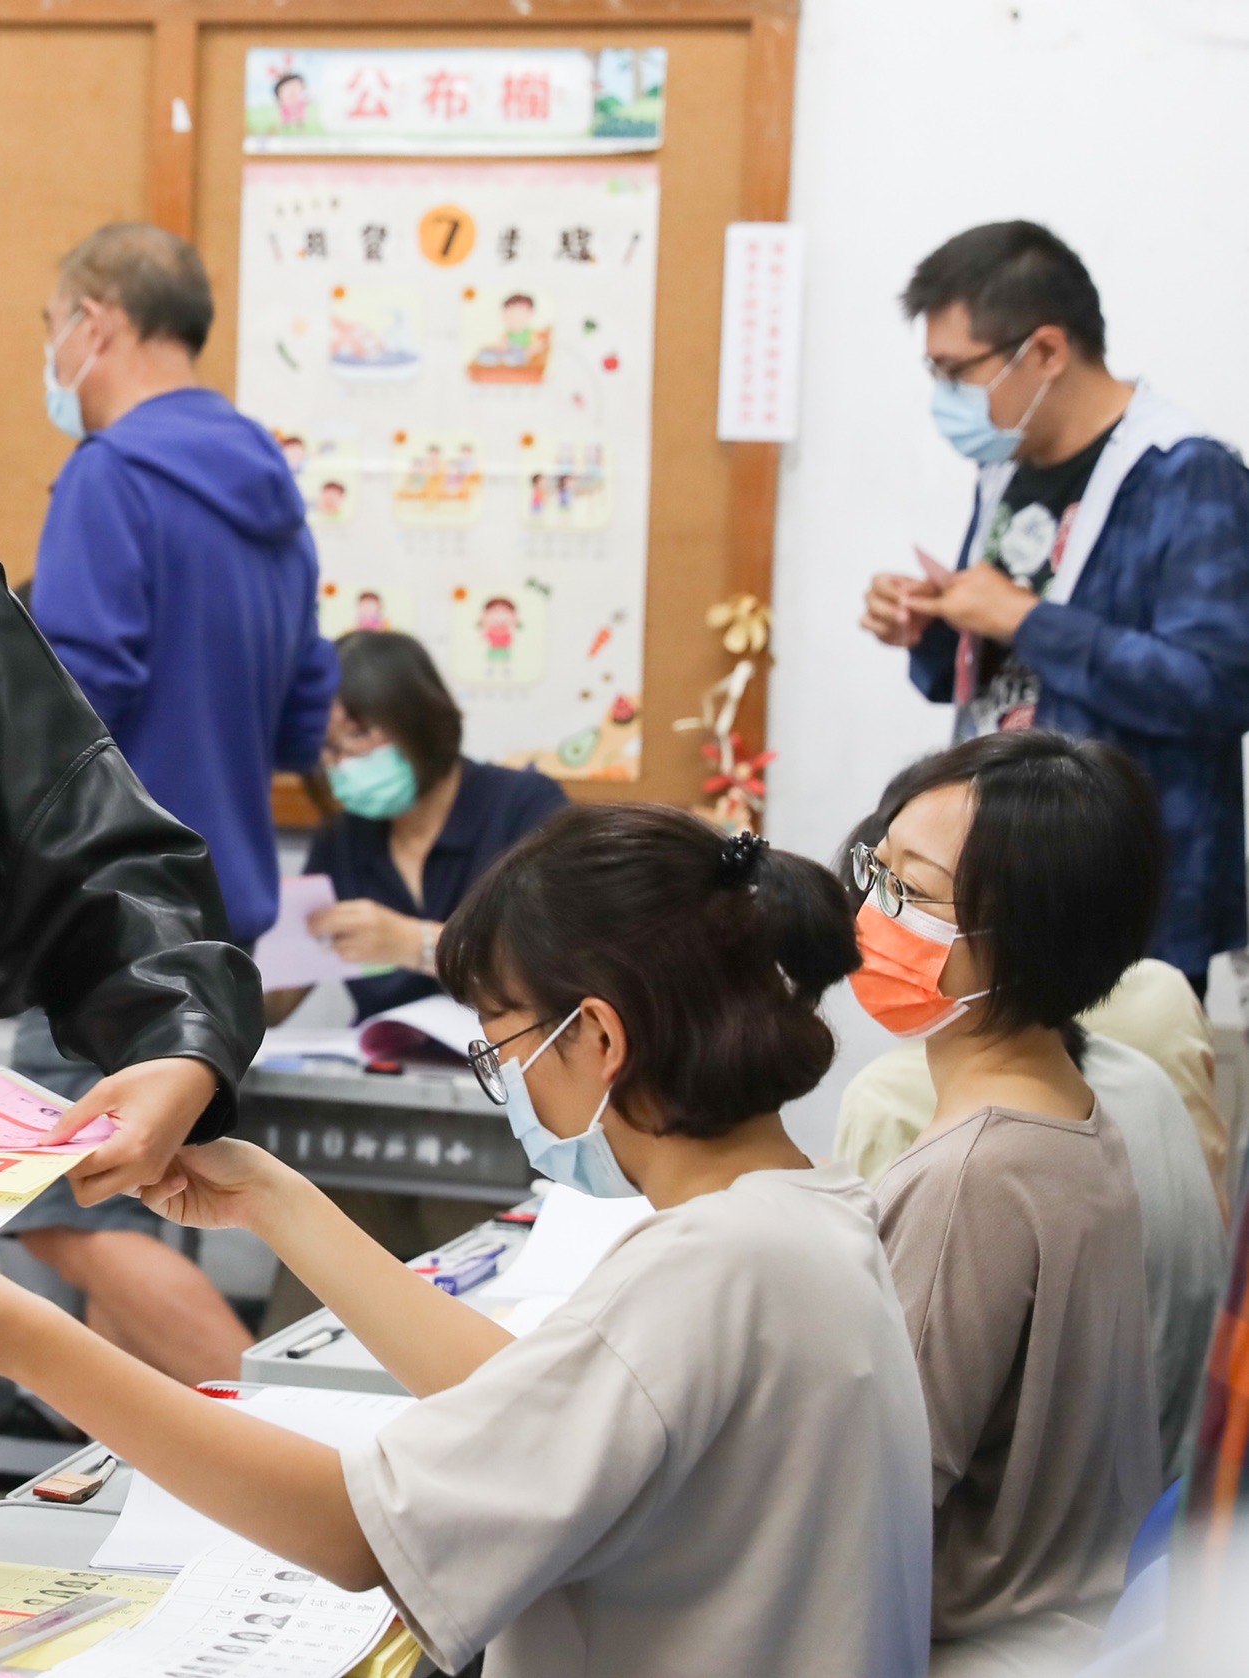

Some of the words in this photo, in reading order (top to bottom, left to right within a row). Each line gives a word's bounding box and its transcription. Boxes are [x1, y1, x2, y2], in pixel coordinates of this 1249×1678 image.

[345, 67, 550, 122] 公布欄
[230, 1587, 250, 1599] 15
